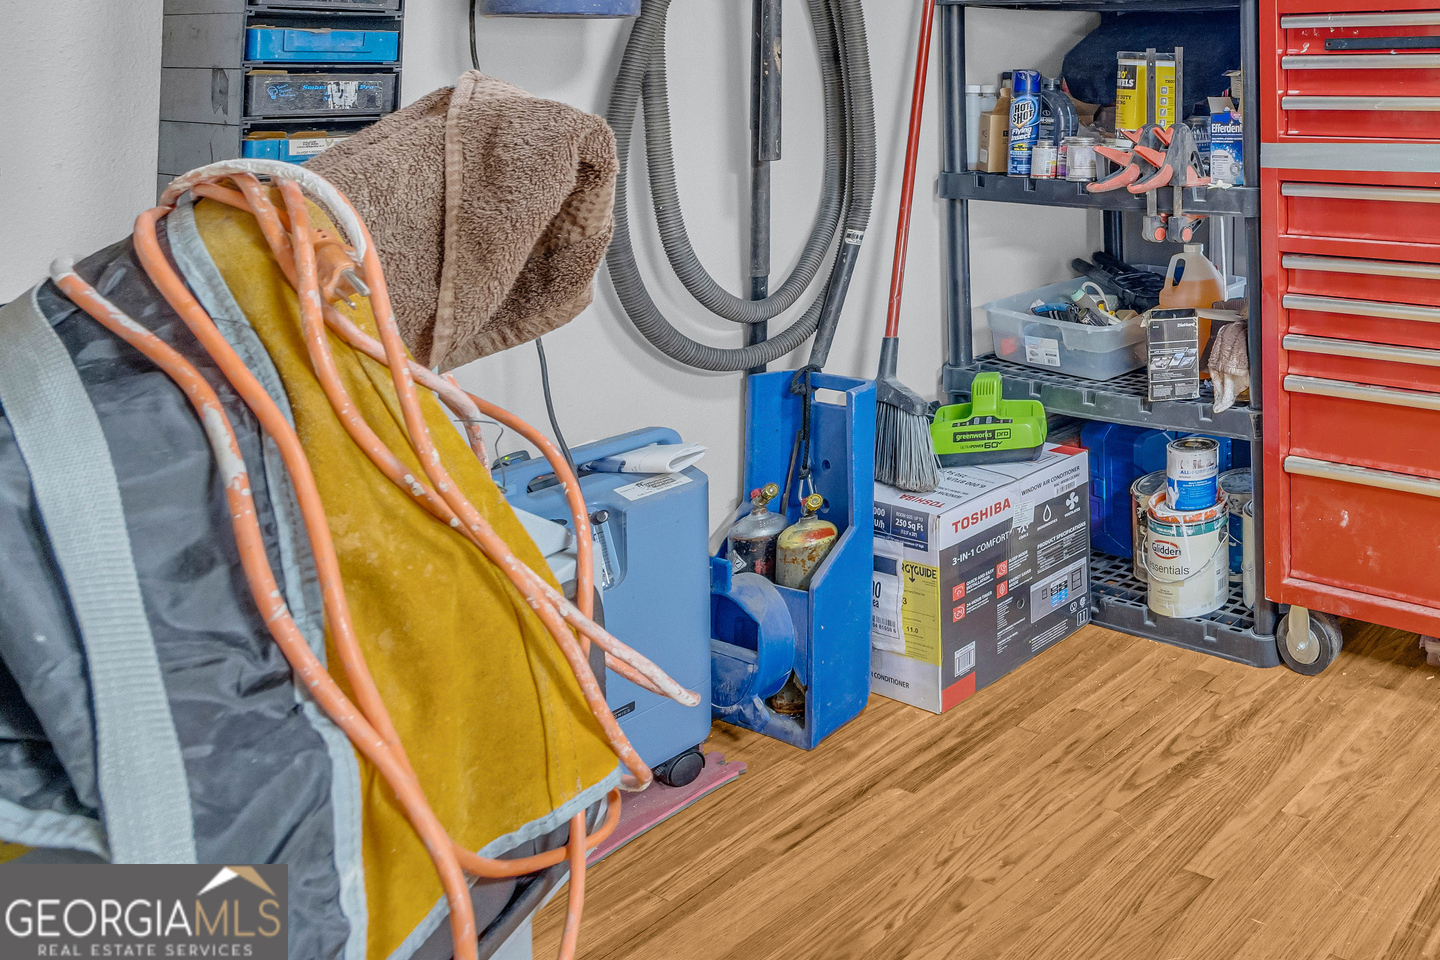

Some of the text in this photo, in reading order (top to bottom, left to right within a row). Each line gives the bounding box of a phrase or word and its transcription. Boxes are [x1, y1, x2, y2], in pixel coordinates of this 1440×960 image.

[1014, 100, 1032, 113] HOT
[1012, 110, 1034, 125] SHOT
[1012, 127, 1032, 136] Flying
[956, 430, 1008, 441] greenworks pro
[1021, 482, 1042, 496] WINDOW
[1042, 479, 1050, 487] AIR
[1050, 466, 1080, 483] CONDITIONER
[900, 494, 946, 508] TOSHIBA
[952, 498, 1011, 534] TOSHIBA
[895, 518, 924, 532] 250 Sq Ft
[1037, 521, 1086, 550] PRODUCT SPECIFICATIONS
[1152, 542, 1182, 556] Glidden
[952, 550, 974, 566] 3-IN-1
[906, 626, 919, 634] 11.0
[874, 673, 909, 689] CONDITIONER
